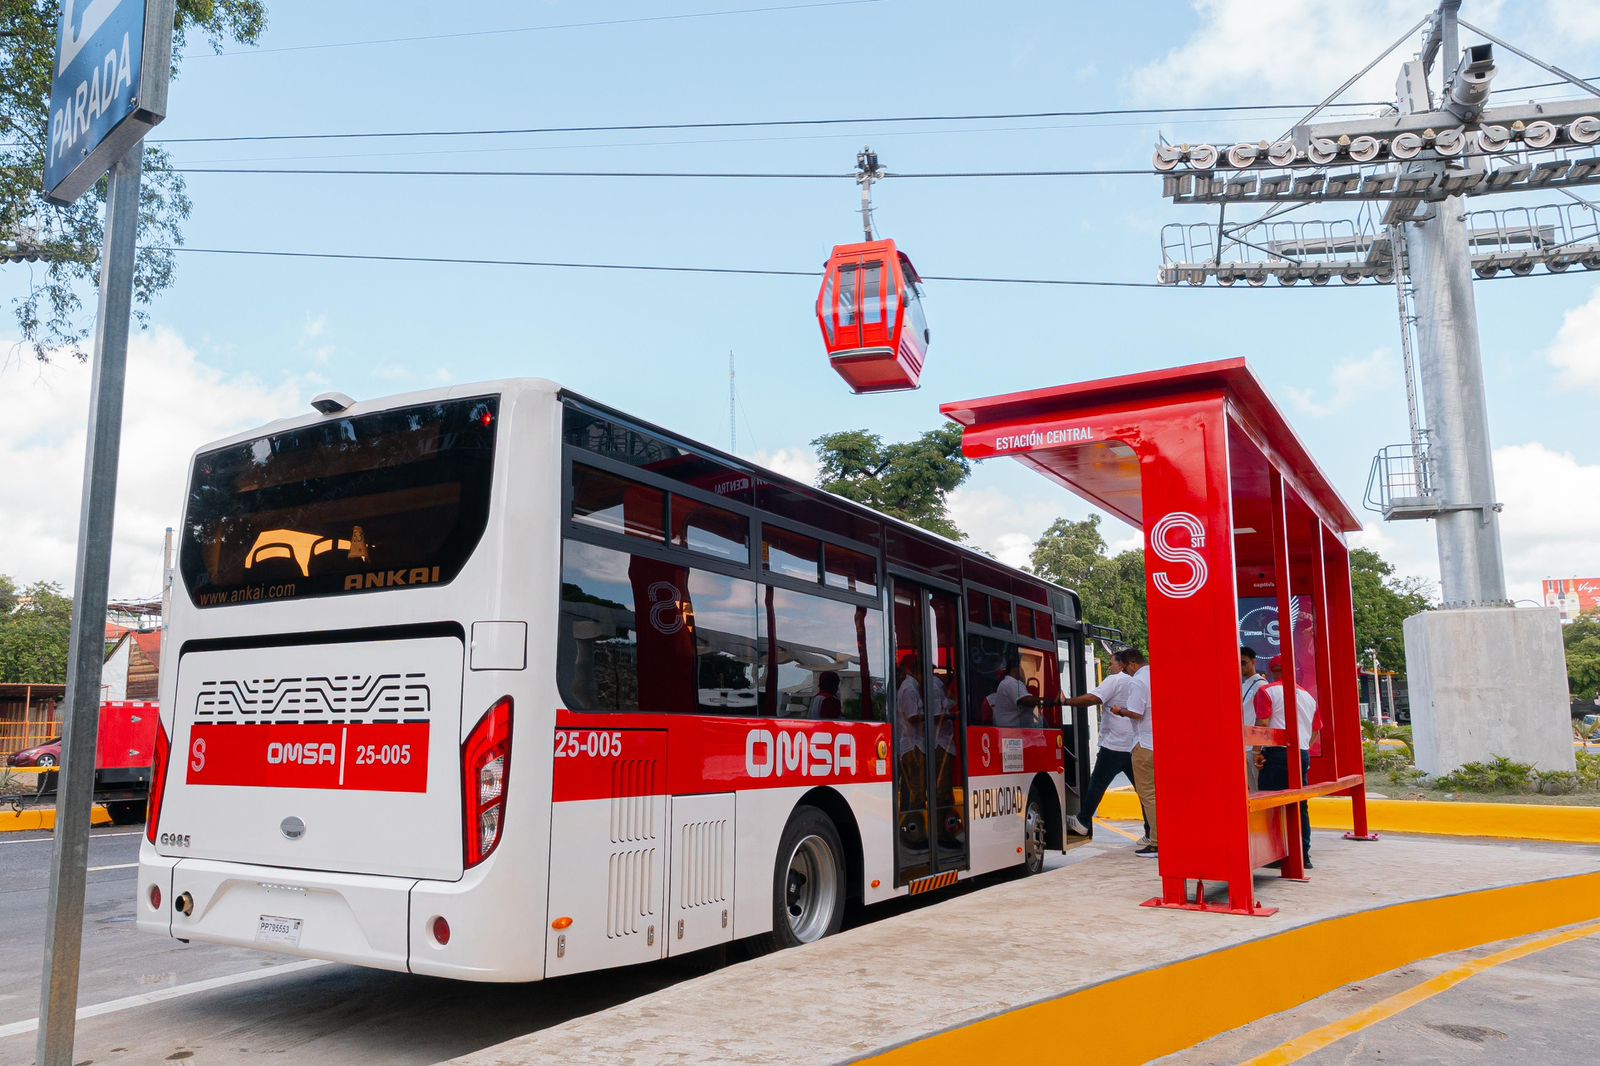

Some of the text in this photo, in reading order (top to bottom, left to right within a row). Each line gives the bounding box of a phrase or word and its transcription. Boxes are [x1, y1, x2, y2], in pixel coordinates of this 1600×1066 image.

[50, 31, 132, 169] PARADA
[995, 426, 1094, 450] ESTACIÓN CENTRAL
[1191, 537, 1206, 548] SIT
[344, 566, 440, 590] ANKAI
[200, 582, 296, 605] www.ankai.com
[267, 742, 336, 765] OMSA
[355, 744, 411, 765] 25-005
[554, 731, 622, 758] 25-005
[745, 729, 856, 777] OMSA
[973, 785, 1023, 820] PUBLICIDAD
[160, 833, 191, 848] G985
